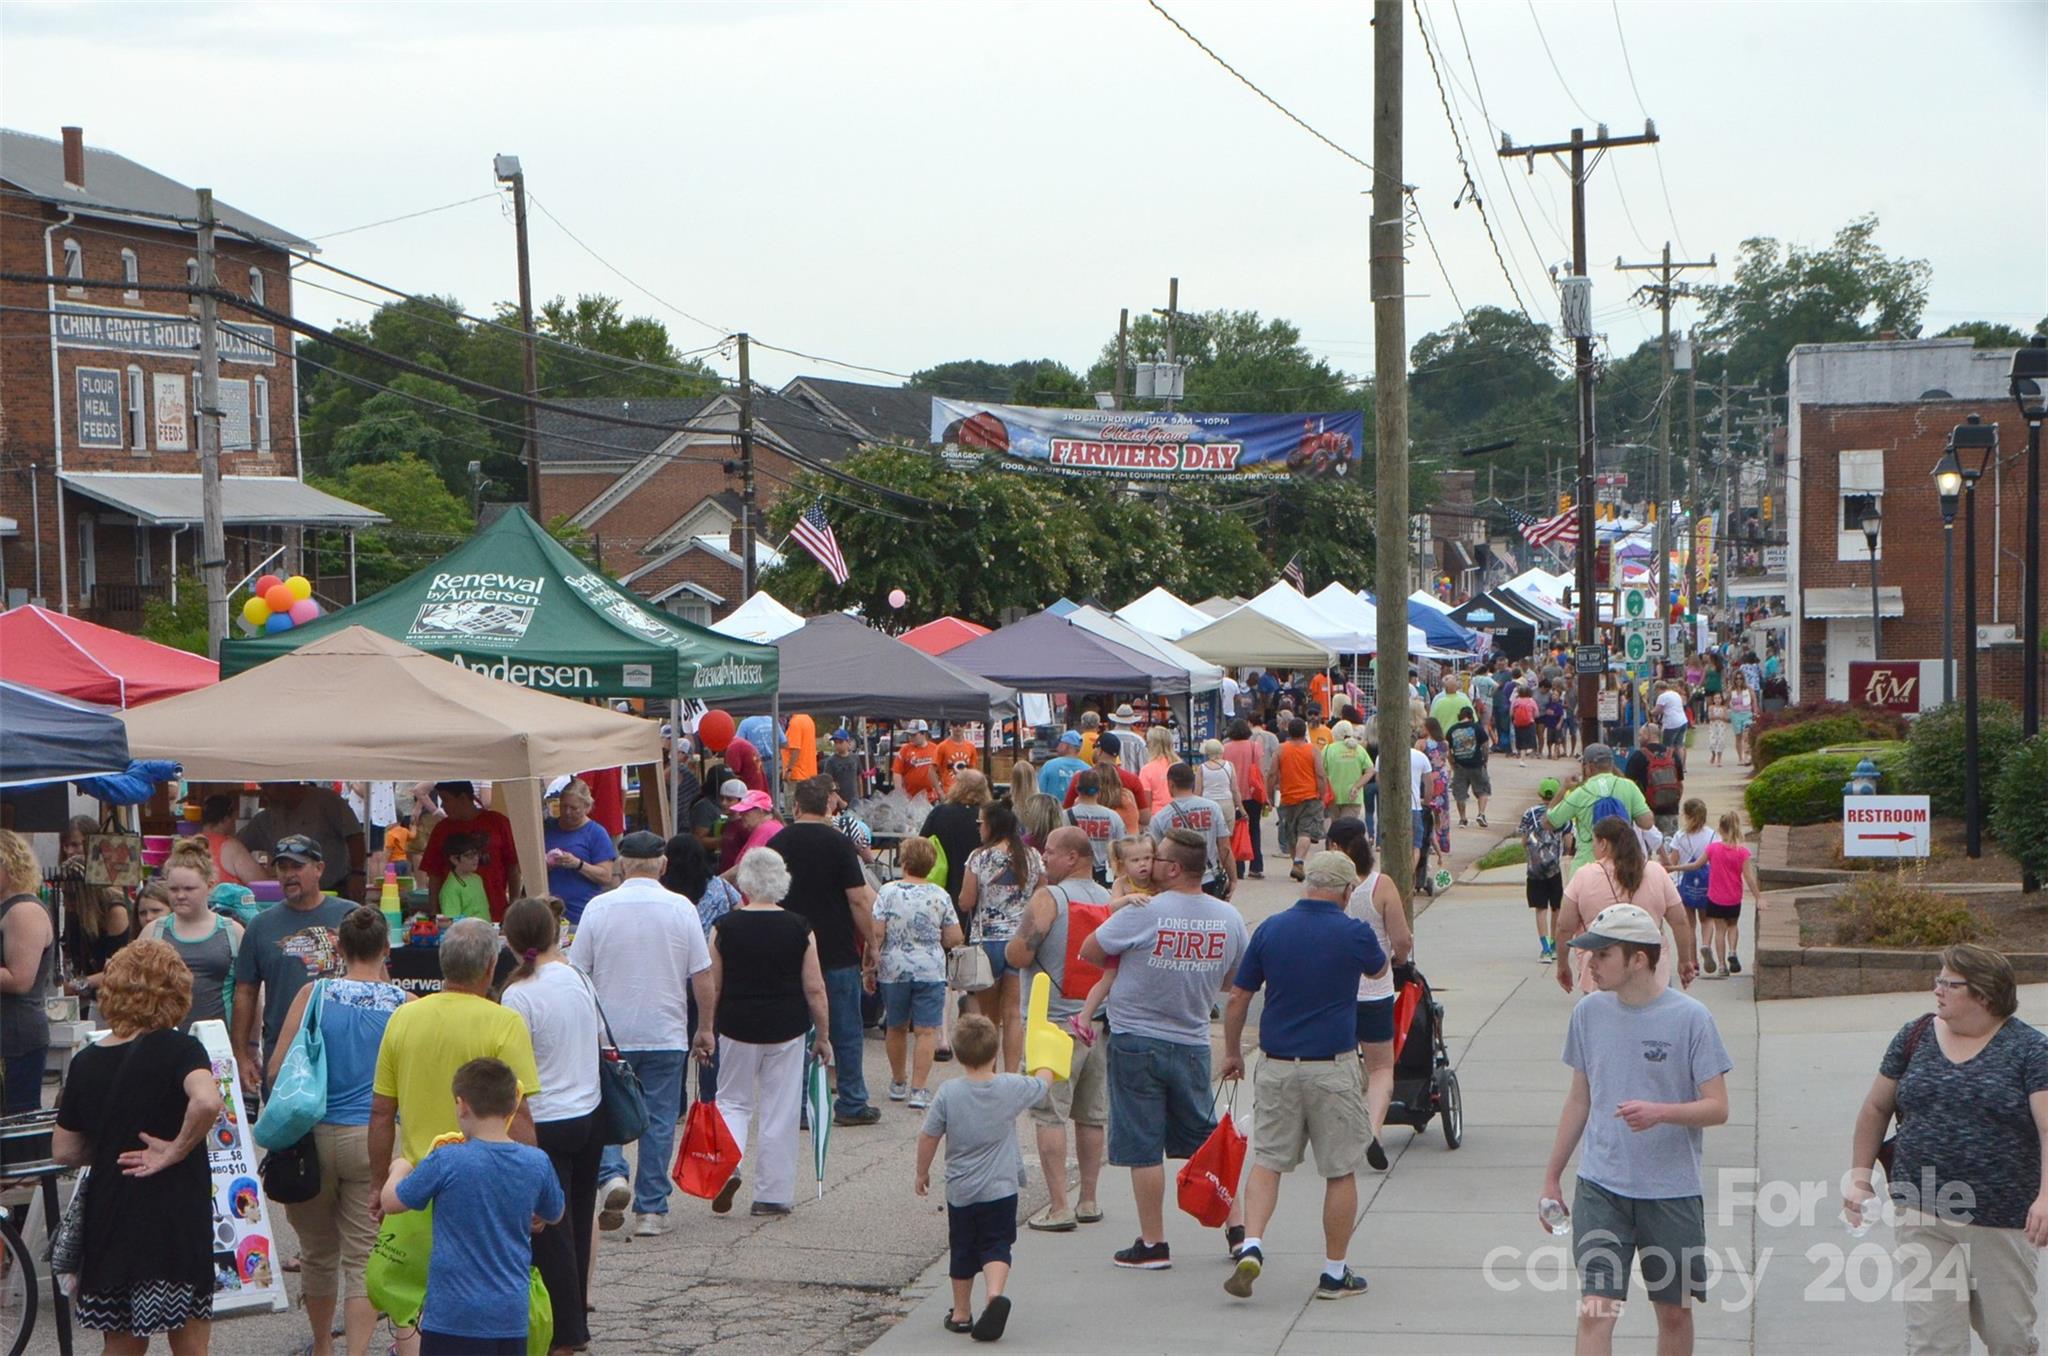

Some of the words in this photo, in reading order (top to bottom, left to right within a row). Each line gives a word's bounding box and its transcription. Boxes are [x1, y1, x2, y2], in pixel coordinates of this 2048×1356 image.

[60, 315, 101, 339] CHINA
[106, 322, 150, 345] GROVE
[154, 323, 200, 348] ROLLE
[82, 377, 114, 395] FLOUR
[85, 399, 112, 416] MEAL
[83, 421, 117, 438] FEEDS
[1082, 415, 1132, 424] SATURDAY
[1145, 416, 1167, 425] JULY
[1171, 416, 1193, 425] 9AM
[1204, 417, 1230, 426] 10PM
[158, 424, 184, 442] FEEDS
[1100, 425, 1144, 441] China
[1144, 427, 1189, 446] Grove
[1051, 438, 1179, 470] FARMERS
[1181, 444, 1240, 471] DAY
[1001, 462, 1025, 472] FOOD,
[1106, 471, 1128, 479] FARM
[430, 573, 544, 594] Renewal
[1633, 648, 1639, 658] 2
[1865, 670, 1918, 705] F&M
[1172, 811, 1211, 830] FRE
[1848, 809, 1926, 823] RESTROOM
[1158, 917, 1188, 930] LONG
[1190, 919, 1226, 930] CREEK
[1152, 929, 1226, 960] FIRE
[1148, 957, 1221, 972] DEPARTMENT
